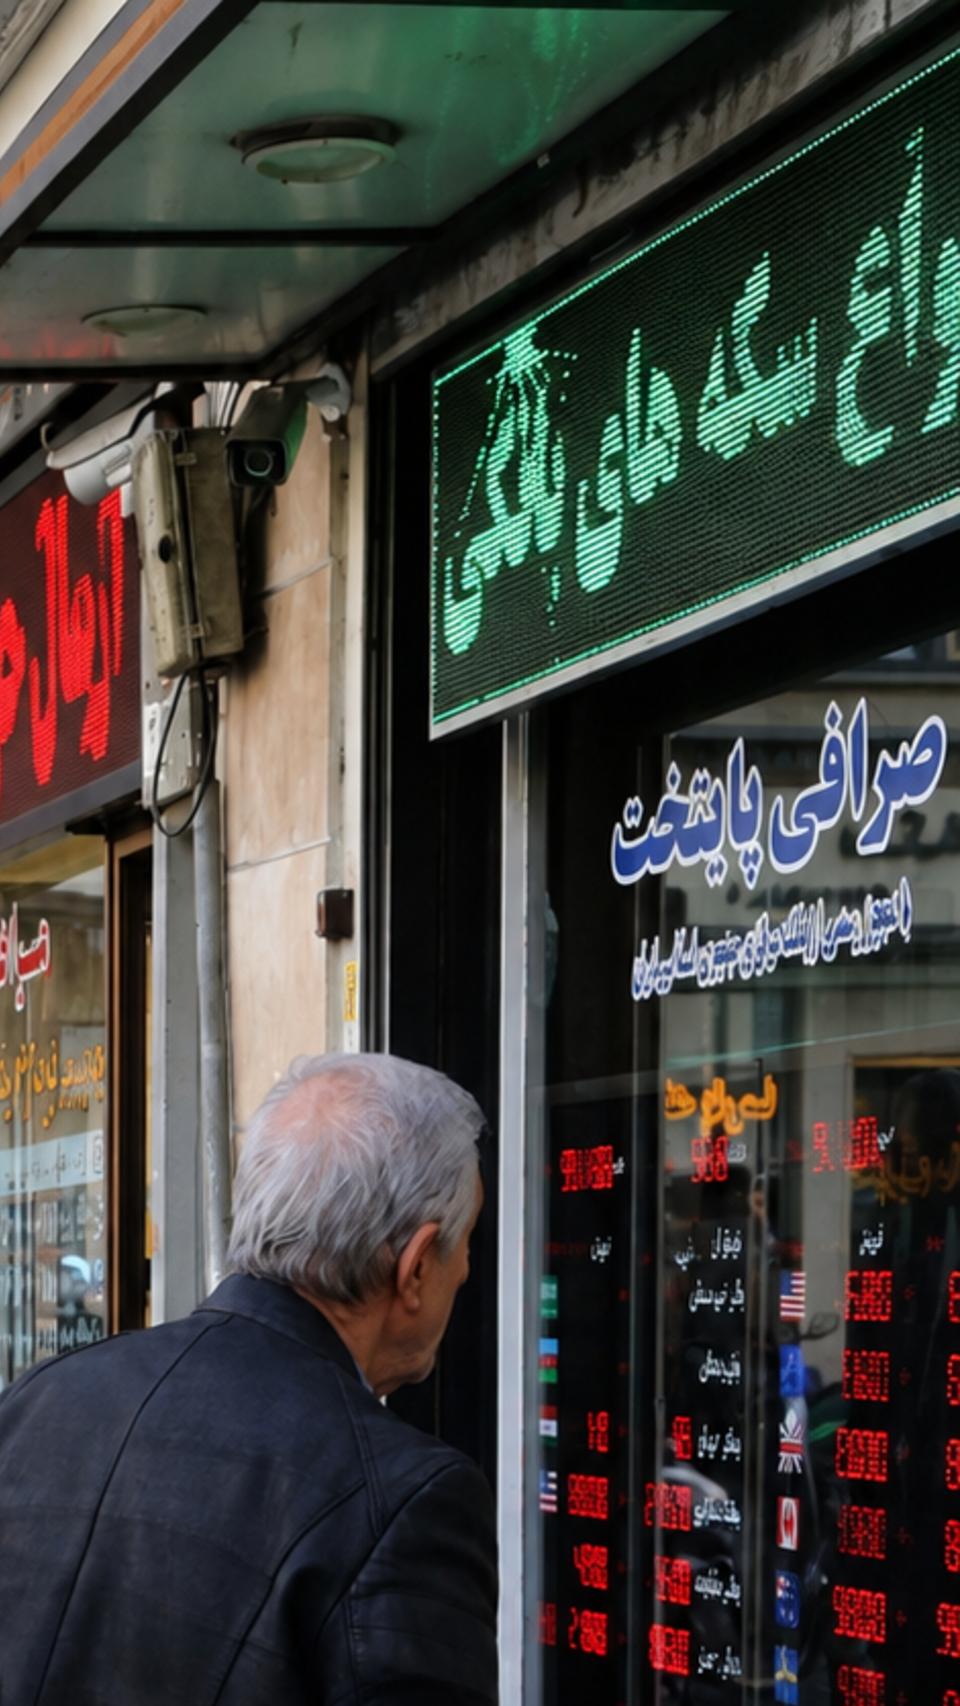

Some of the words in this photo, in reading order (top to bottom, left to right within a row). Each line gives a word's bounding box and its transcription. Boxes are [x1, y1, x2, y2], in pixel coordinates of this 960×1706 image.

[696, 251, 818, 461] سکه
[835, 126, 960, 466] واع
[575, 328, 682, 593] های
[611, 737, 763, 890] پایتخت
[769, 697, 947, 875] صرافی
